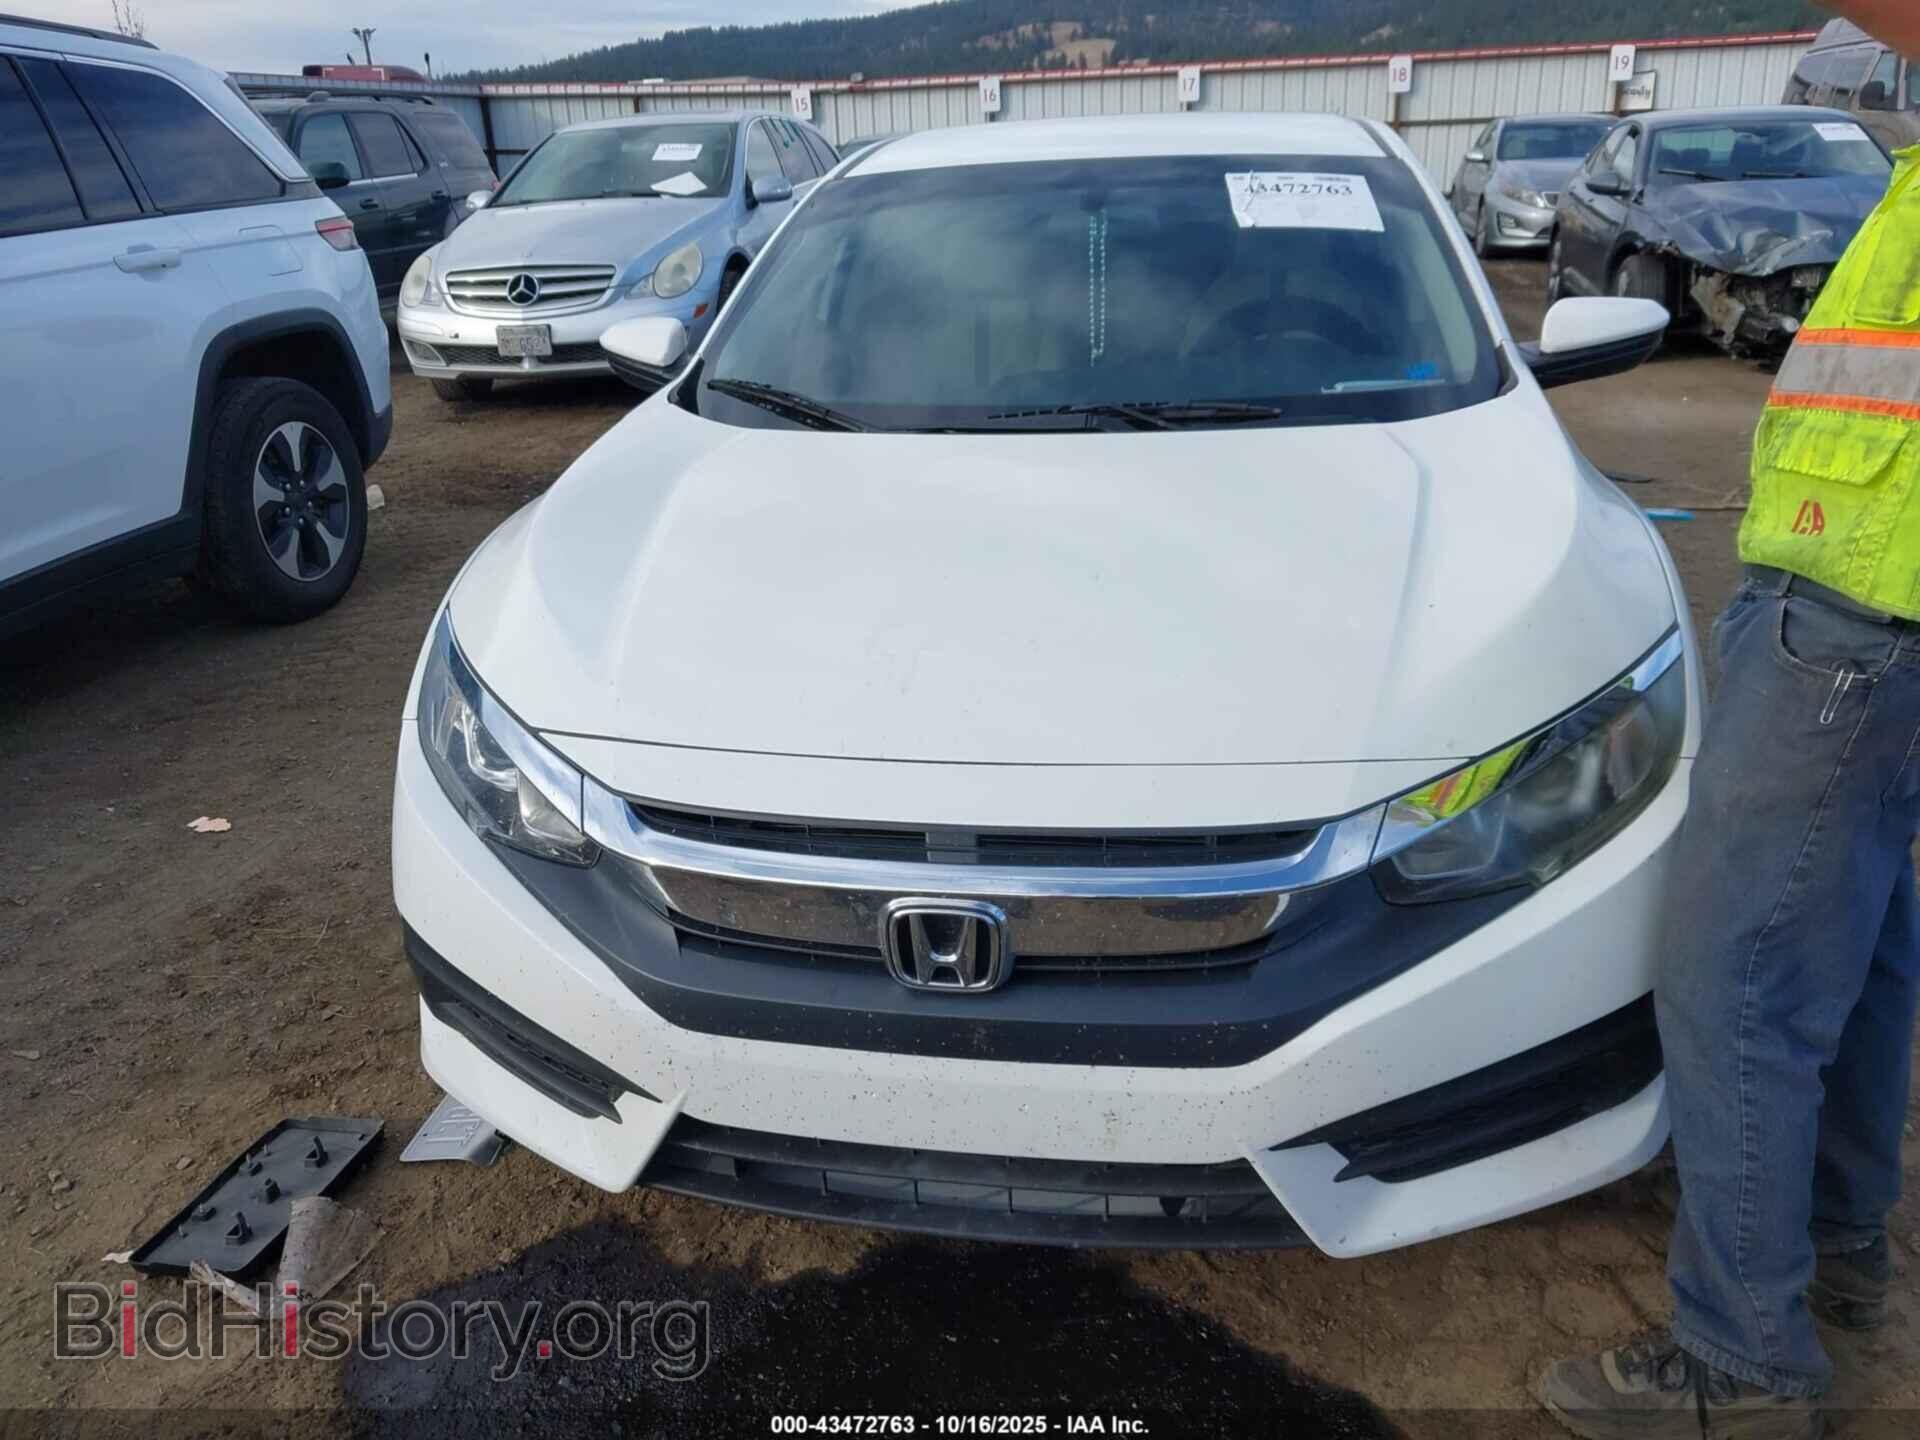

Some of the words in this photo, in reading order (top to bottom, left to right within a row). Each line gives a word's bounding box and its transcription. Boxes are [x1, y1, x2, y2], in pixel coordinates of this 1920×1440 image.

[1615, 55, 1630, 70] 19
[1392, 67, 1408, 82] 18
[1182, 77, 1195, 91] 17
[984, 88, 997, 103] 16
[796, 96, 808, 111] 15
